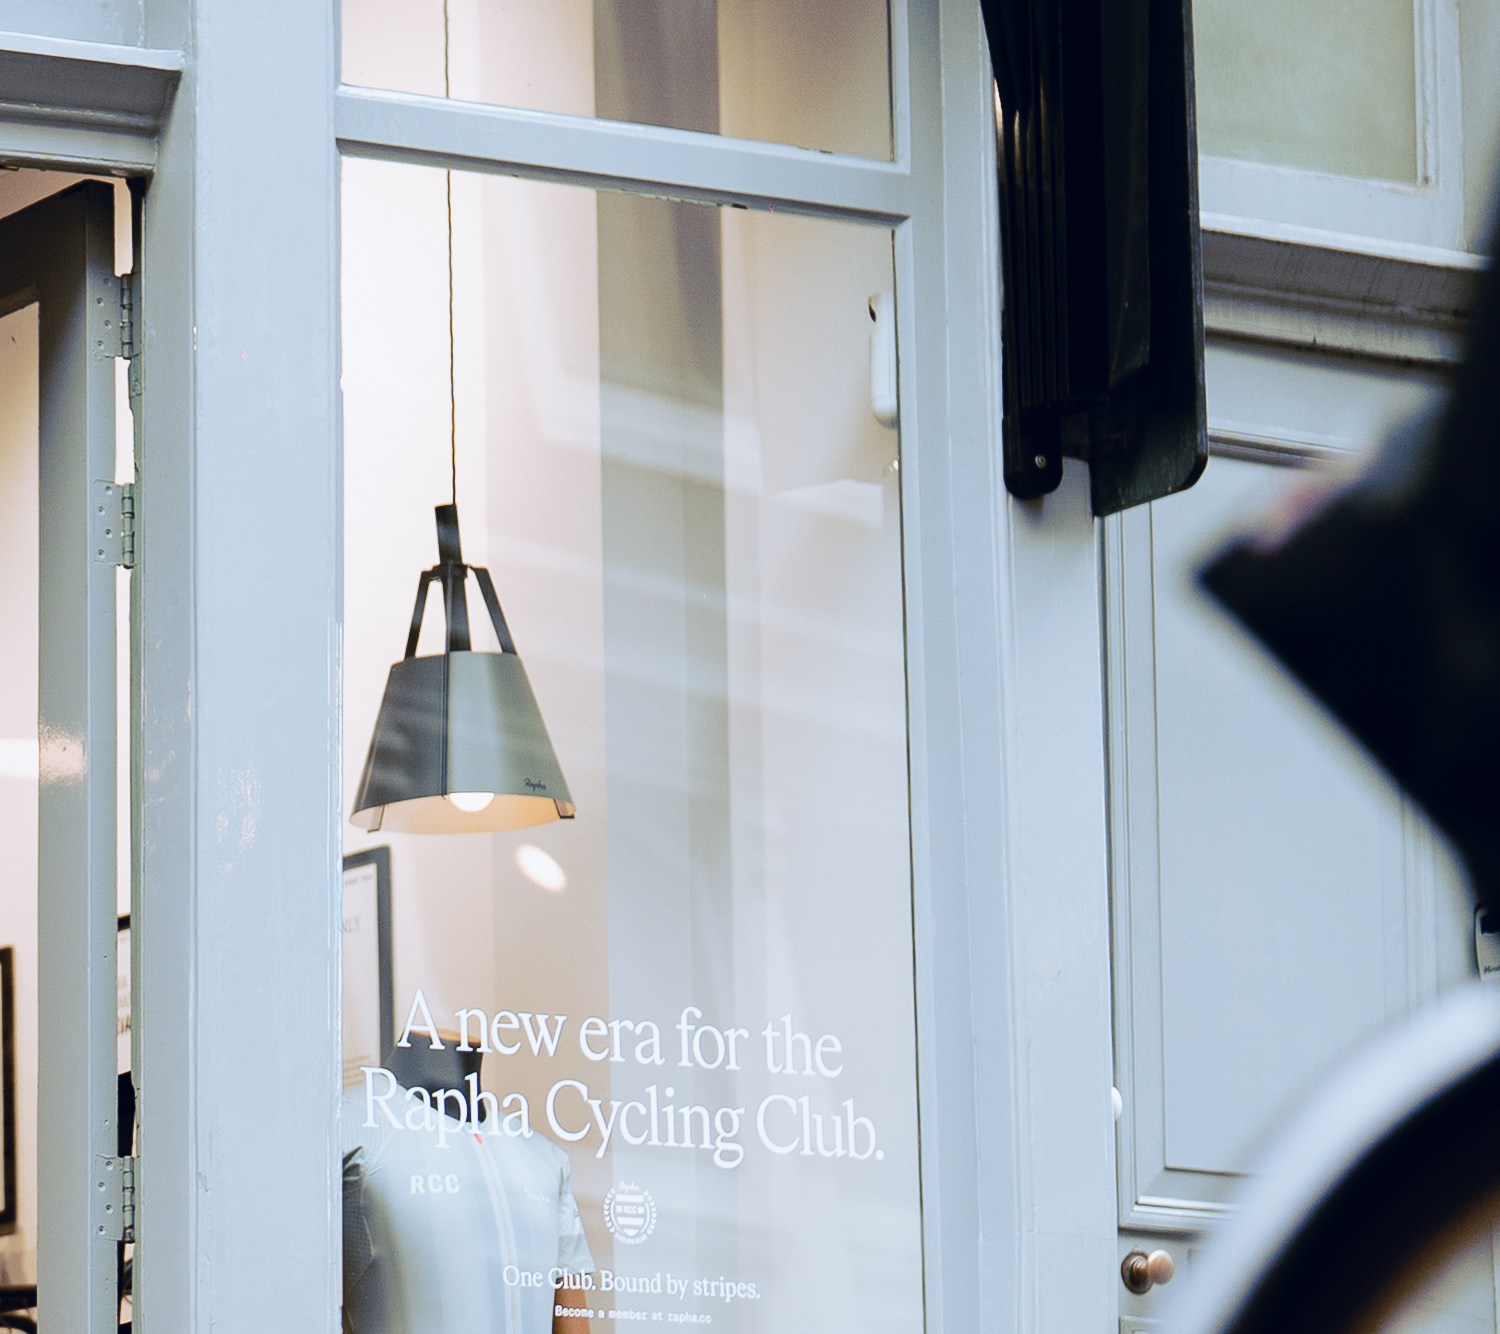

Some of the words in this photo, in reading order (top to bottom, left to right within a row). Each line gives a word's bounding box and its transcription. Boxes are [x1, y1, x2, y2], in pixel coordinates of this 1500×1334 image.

[397, 987, 446, 1050] A
[455, 1009, 566, 1057] new
[579, 1015, 665, 1066] era
[676, 1006, 749, 1070] for
[762, 1014, 844, 1078] the
[360, 1067, 532, 1149] Rapha
[545, 1079, 745, 1170] Cycling
[756, 1094, 885, 1161] Club.
[410, 1174, 460, 1194] RCC
[503, 1265, 543, 1287] One
[547, 1266, 597, 1291] Club.
[600, 1269, 663, 1294] Bound
[666, 1273, 688, 1300] by
[693, 1276, 761, 1303] stripes.
[554, 1304, 594, 1319] Become
[609, 1308, 647, 1321] member
[651, 1311, 663, 1321] at
